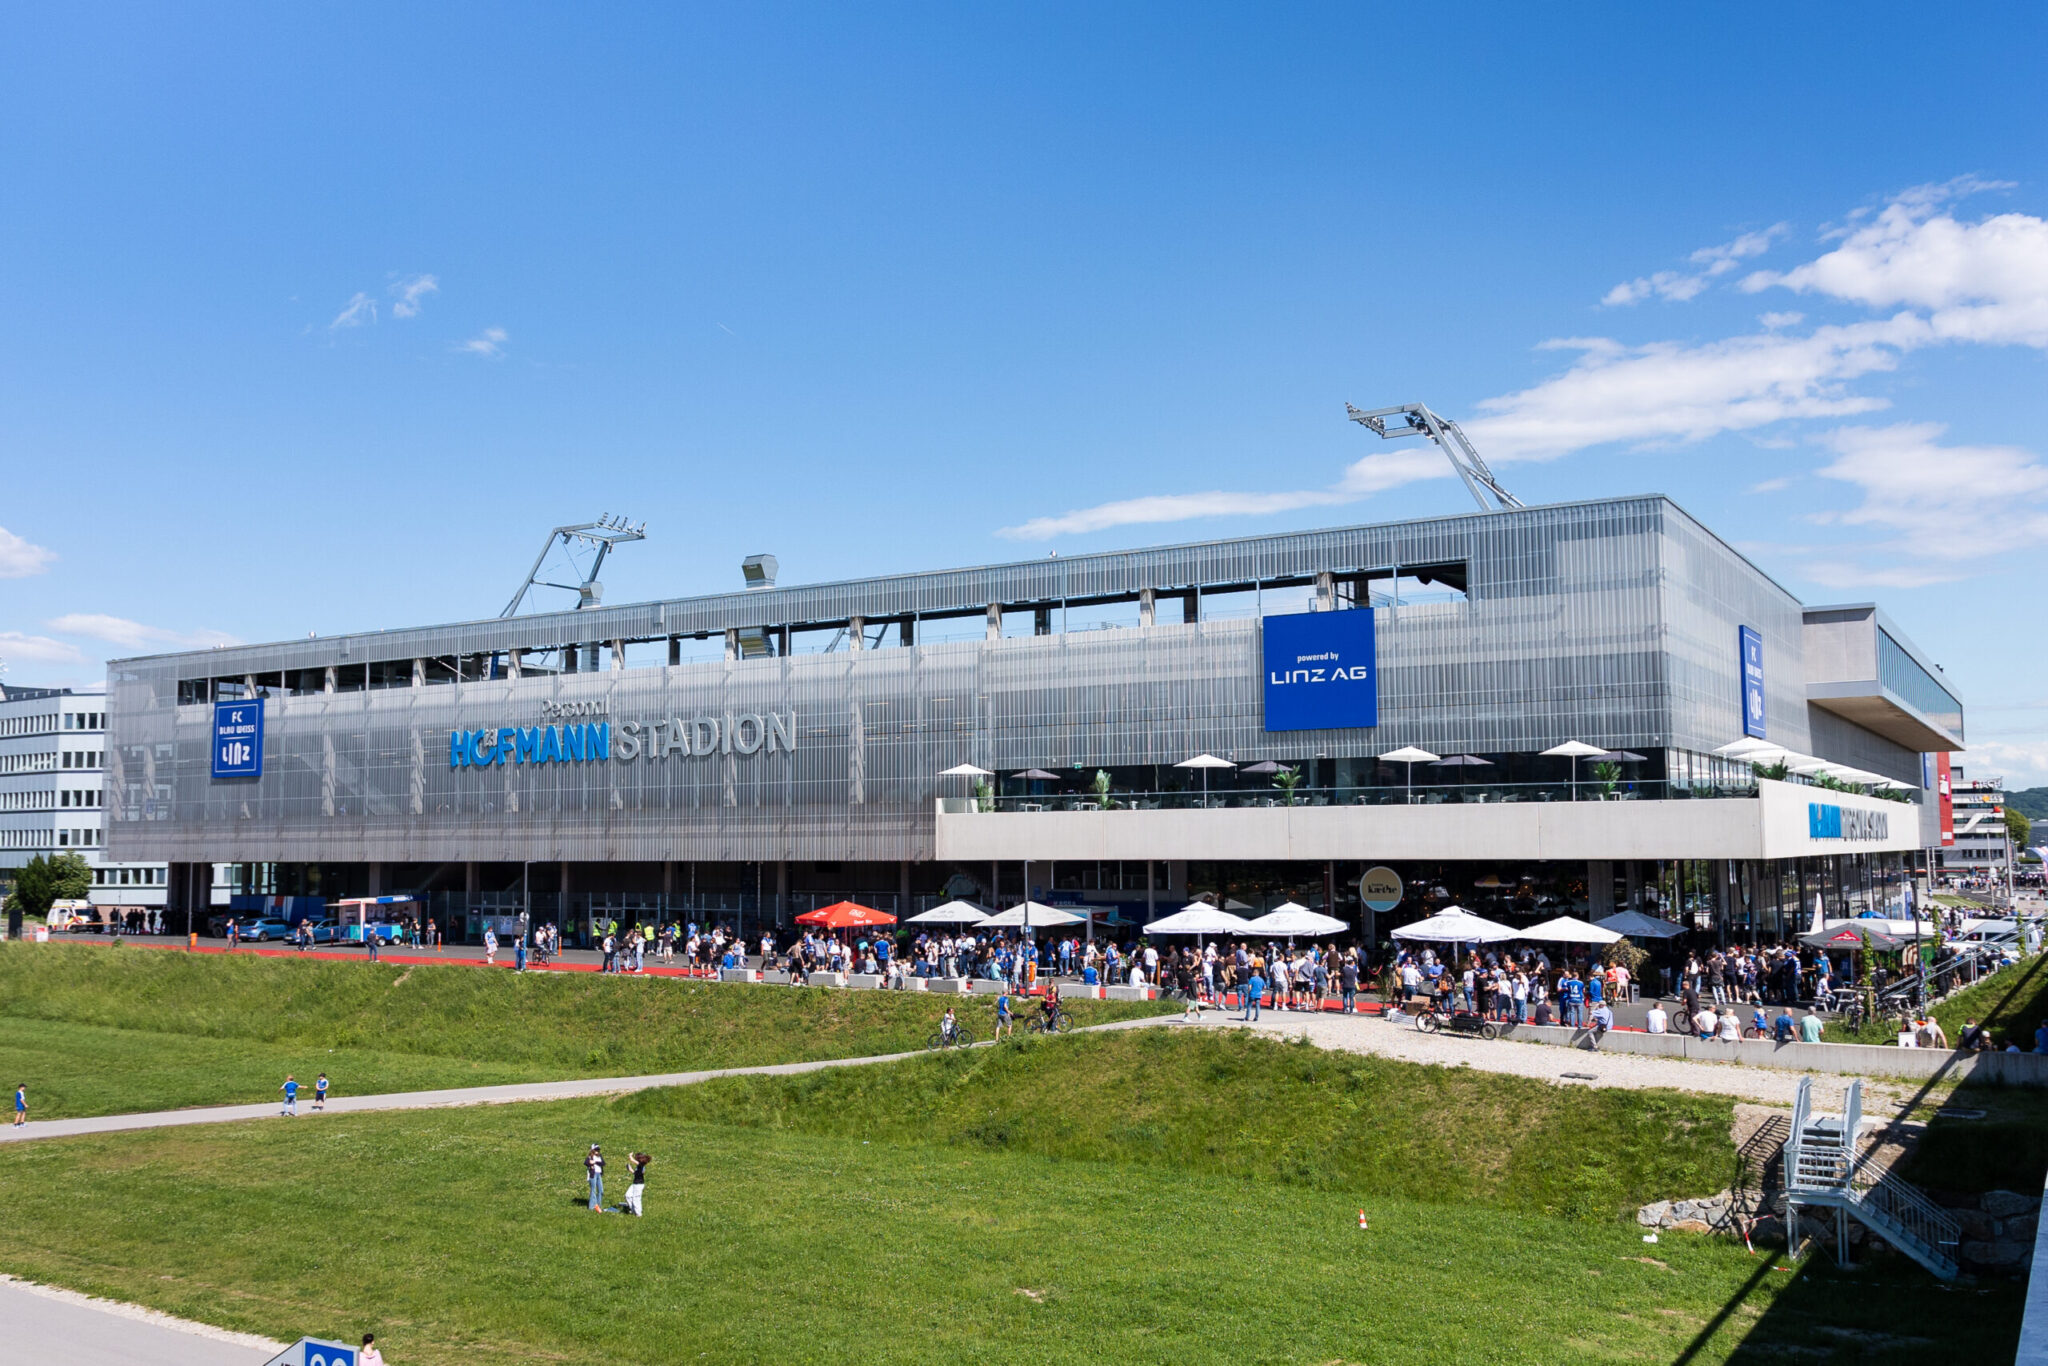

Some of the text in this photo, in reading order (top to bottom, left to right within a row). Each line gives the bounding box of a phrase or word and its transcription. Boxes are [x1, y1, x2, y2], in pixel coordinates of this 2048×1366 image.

[1297, 651, 1339, 664] powered by
[1271, 666, 1367, 685] LINZ AG
[231, 710, 243, 723] FC
[219, 724, 255, 735] BLAU WEISS
[450, 721, 609, 767] HOFMANN
[615, 710, 797, 761] STADION
[1569, 984, 1579, 994] 14
